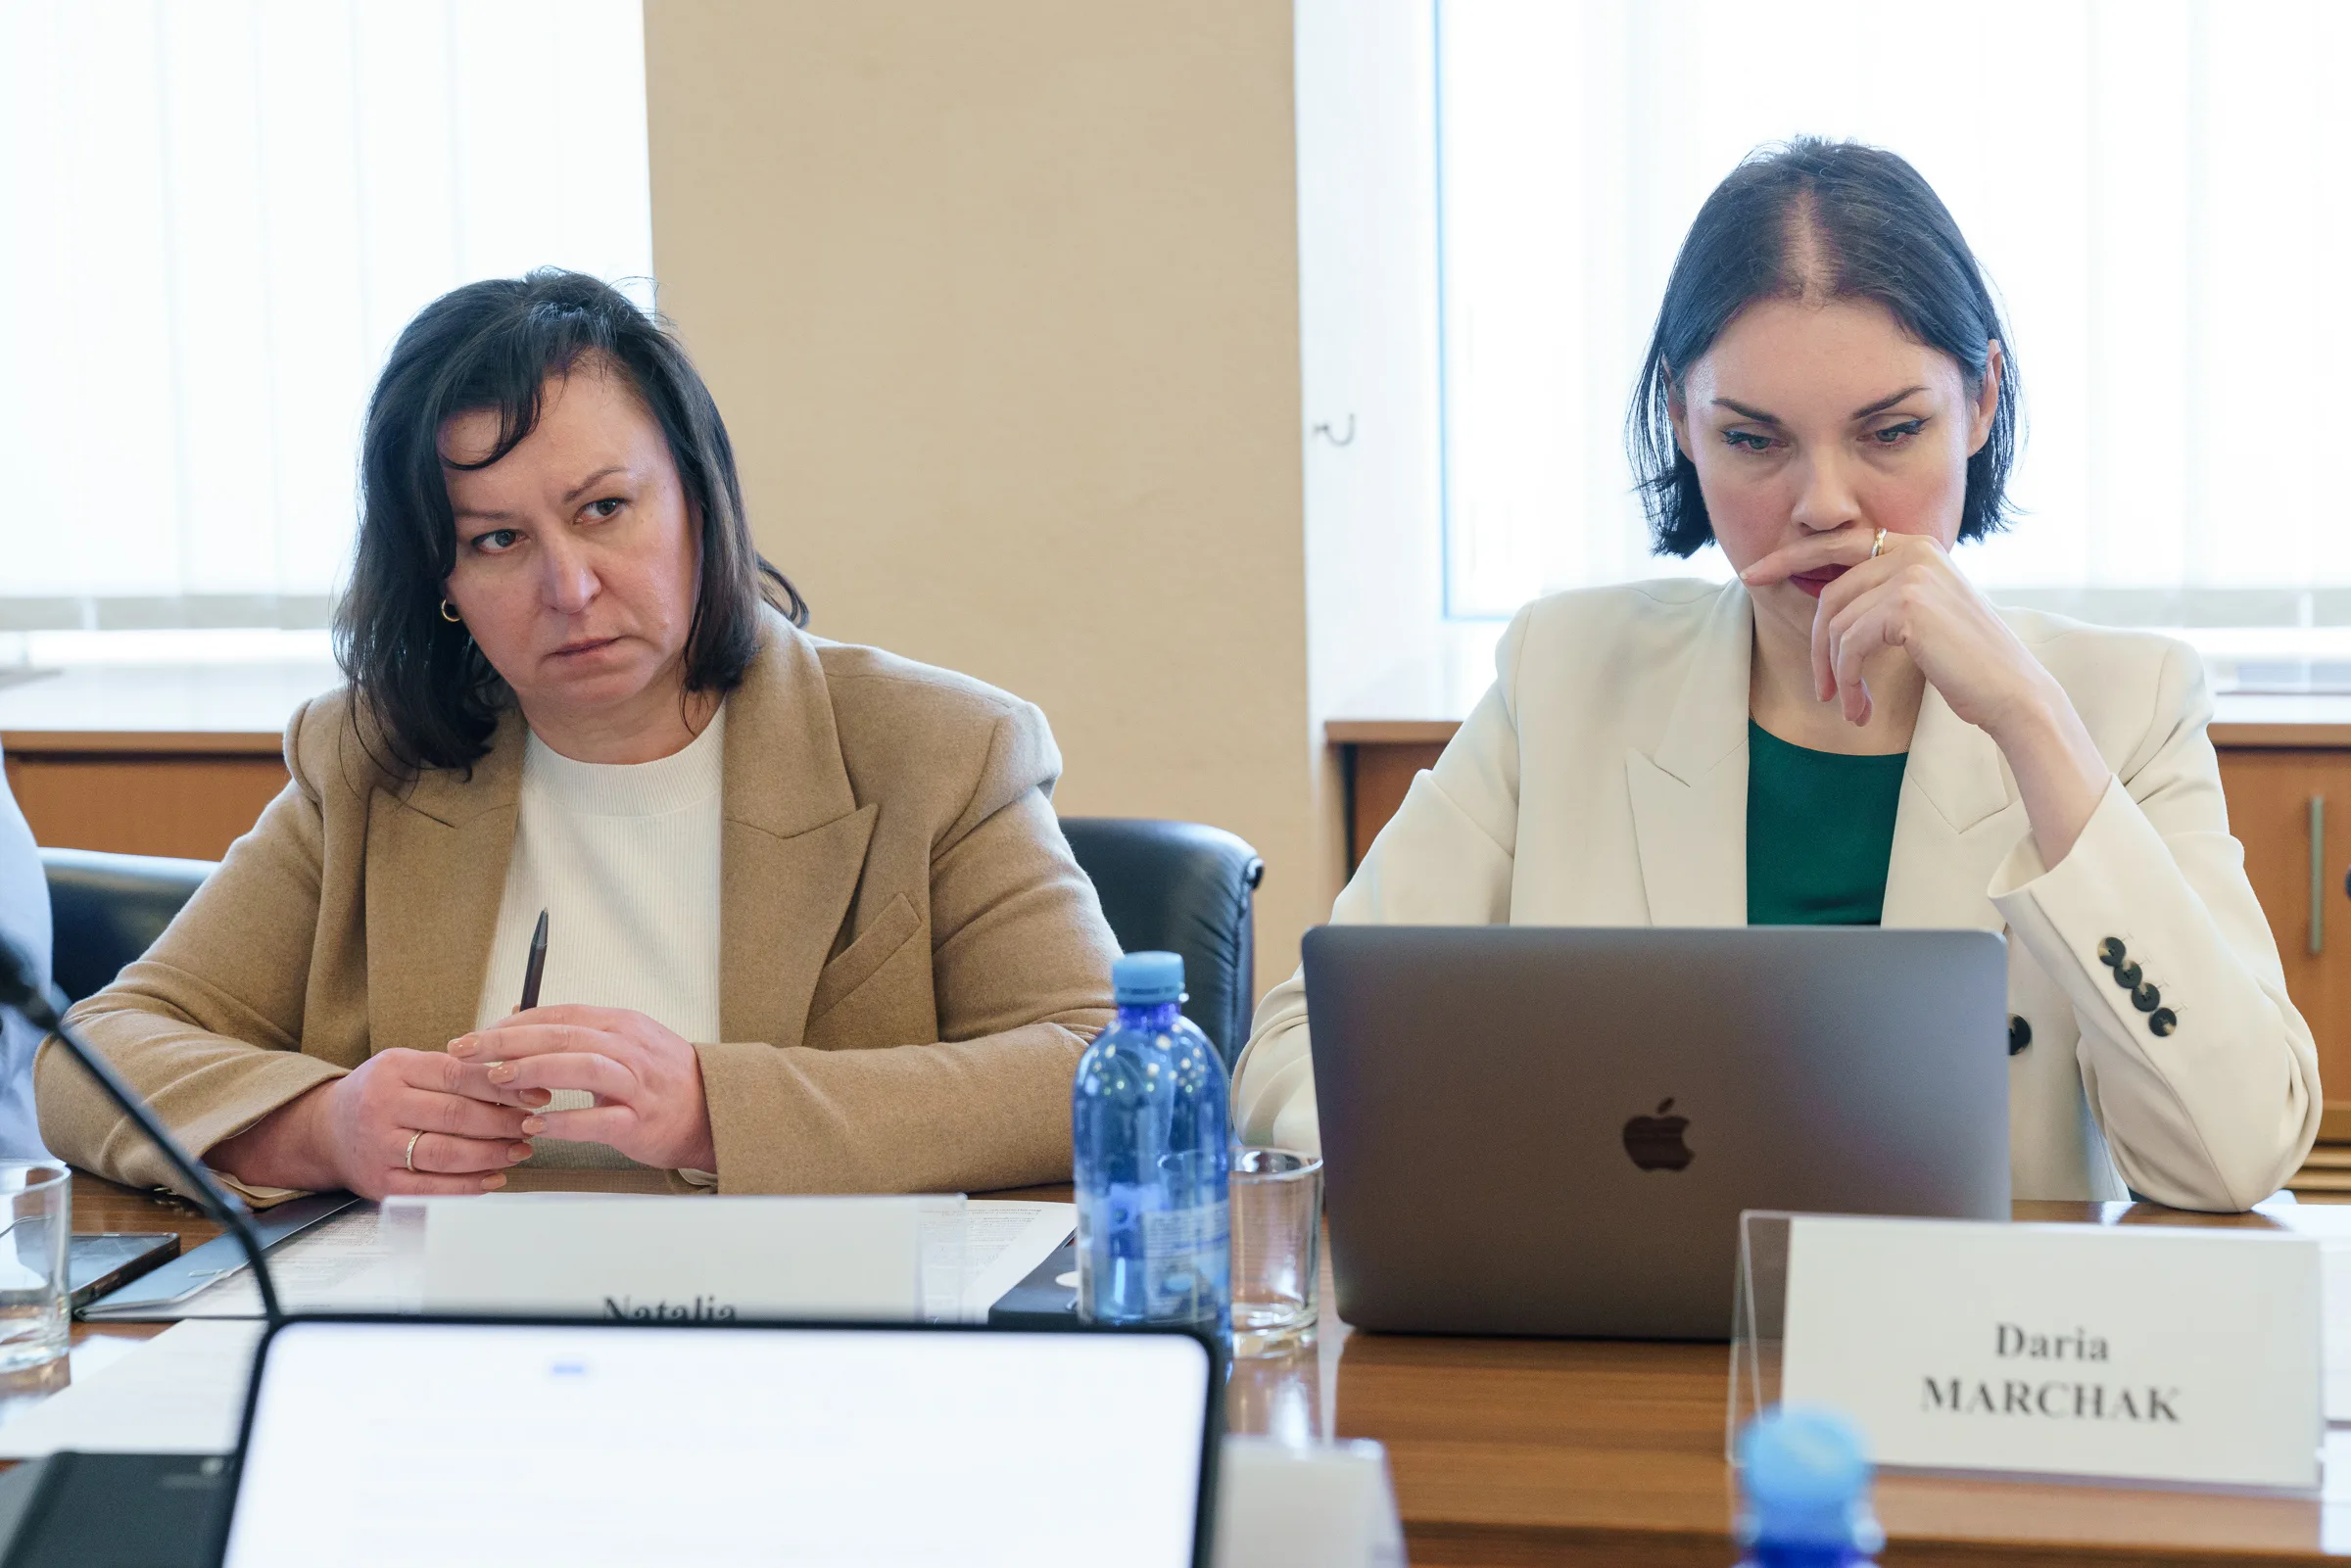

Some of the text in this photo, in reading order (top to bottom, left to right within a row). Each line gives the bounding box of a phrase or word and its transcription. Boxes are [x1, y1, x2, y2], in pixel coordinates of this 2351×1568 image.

[603, 1294, 738, 1320] Natalia
[1994, 1322, 2109, 1360] Daria
[1921, 1375, 2180, 1423] MARCHAK
